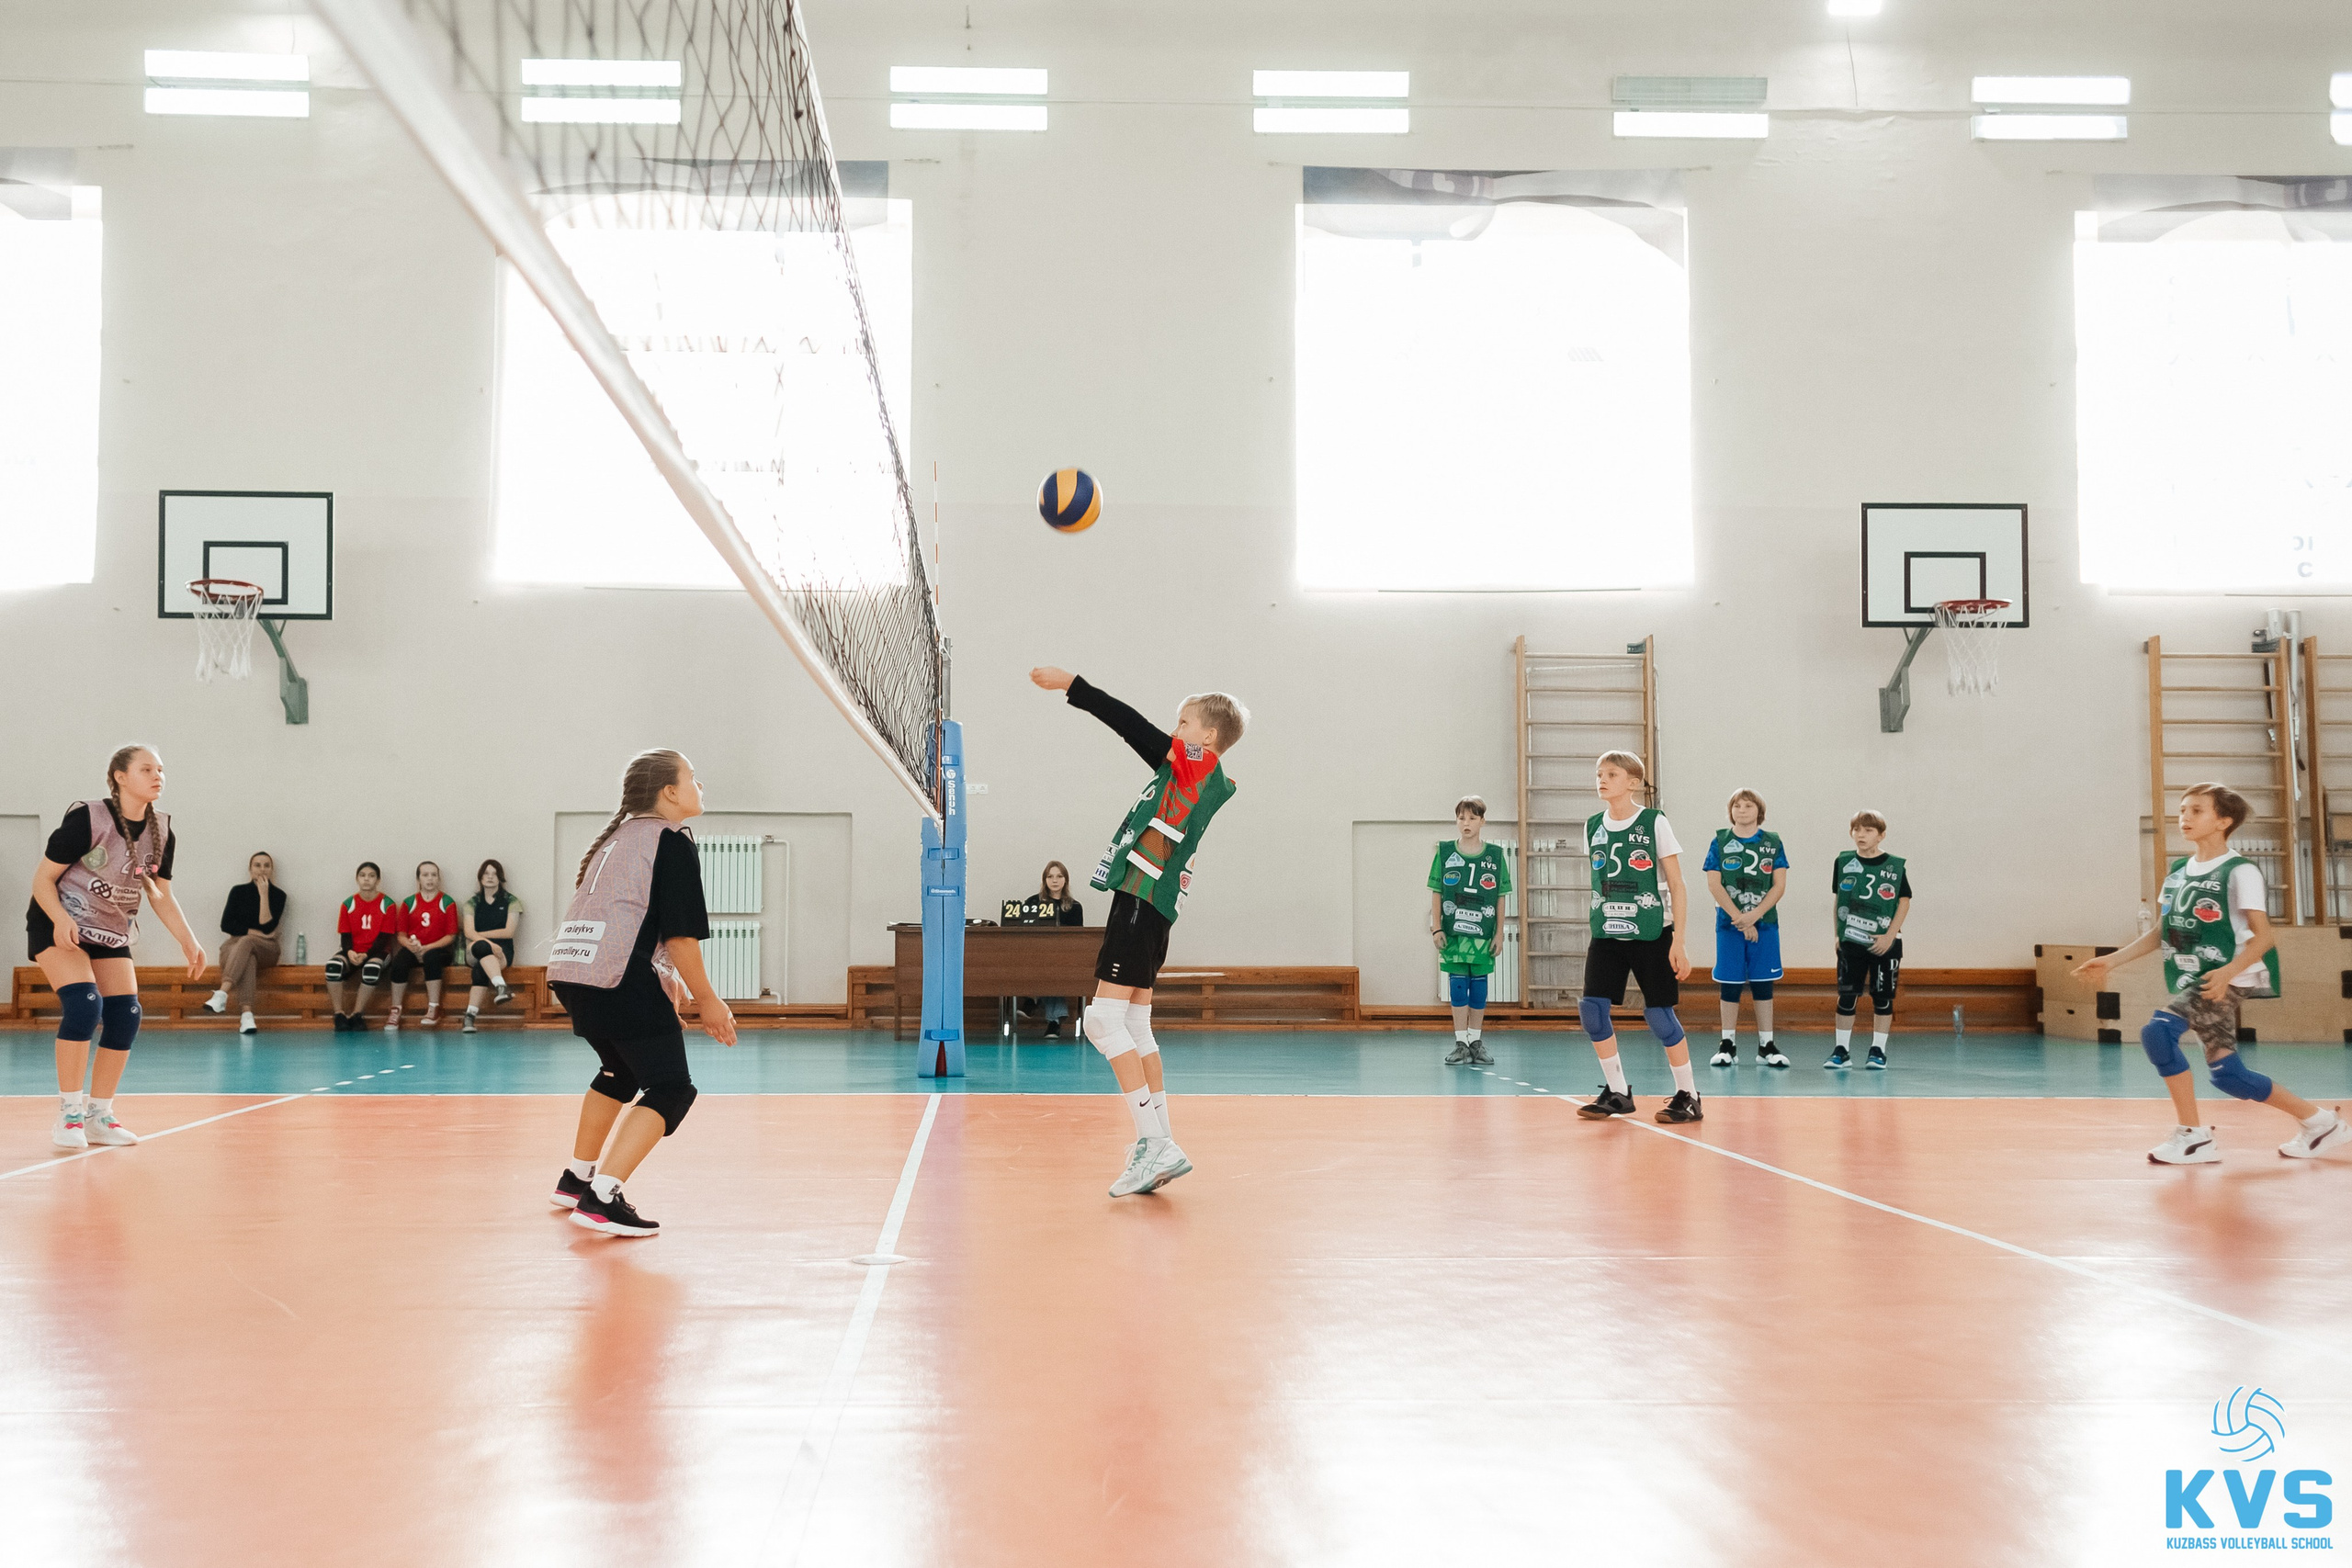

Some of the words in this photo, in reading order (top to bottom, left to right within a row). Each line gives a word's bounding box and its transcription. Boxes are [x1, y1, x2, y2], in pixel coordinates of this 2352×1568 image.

[1628, 833, 1650, 844] KVS
[1759, 846, 1777, 854] KVS
[588, 840, 618, 895] 1
[1480, 861, 1498, 870] KVS
[1607, 842, 1623, 878] 5
[1744, 849, 1758, 875] 2
[1468, 863, 1476, 886] 1
[1880, 870, 1898, 881] KVS
[1859, 874, 1875, 900] 3
[1004, 904, 1021, 918] 24
[1023, 905, 1029, 913] 0
[1031, 905, 1038, 913] 2
[1039, 903, 1055, 918] 24
[361, 914, 372, 930] 11
[421, 912, 431, 928] 3
